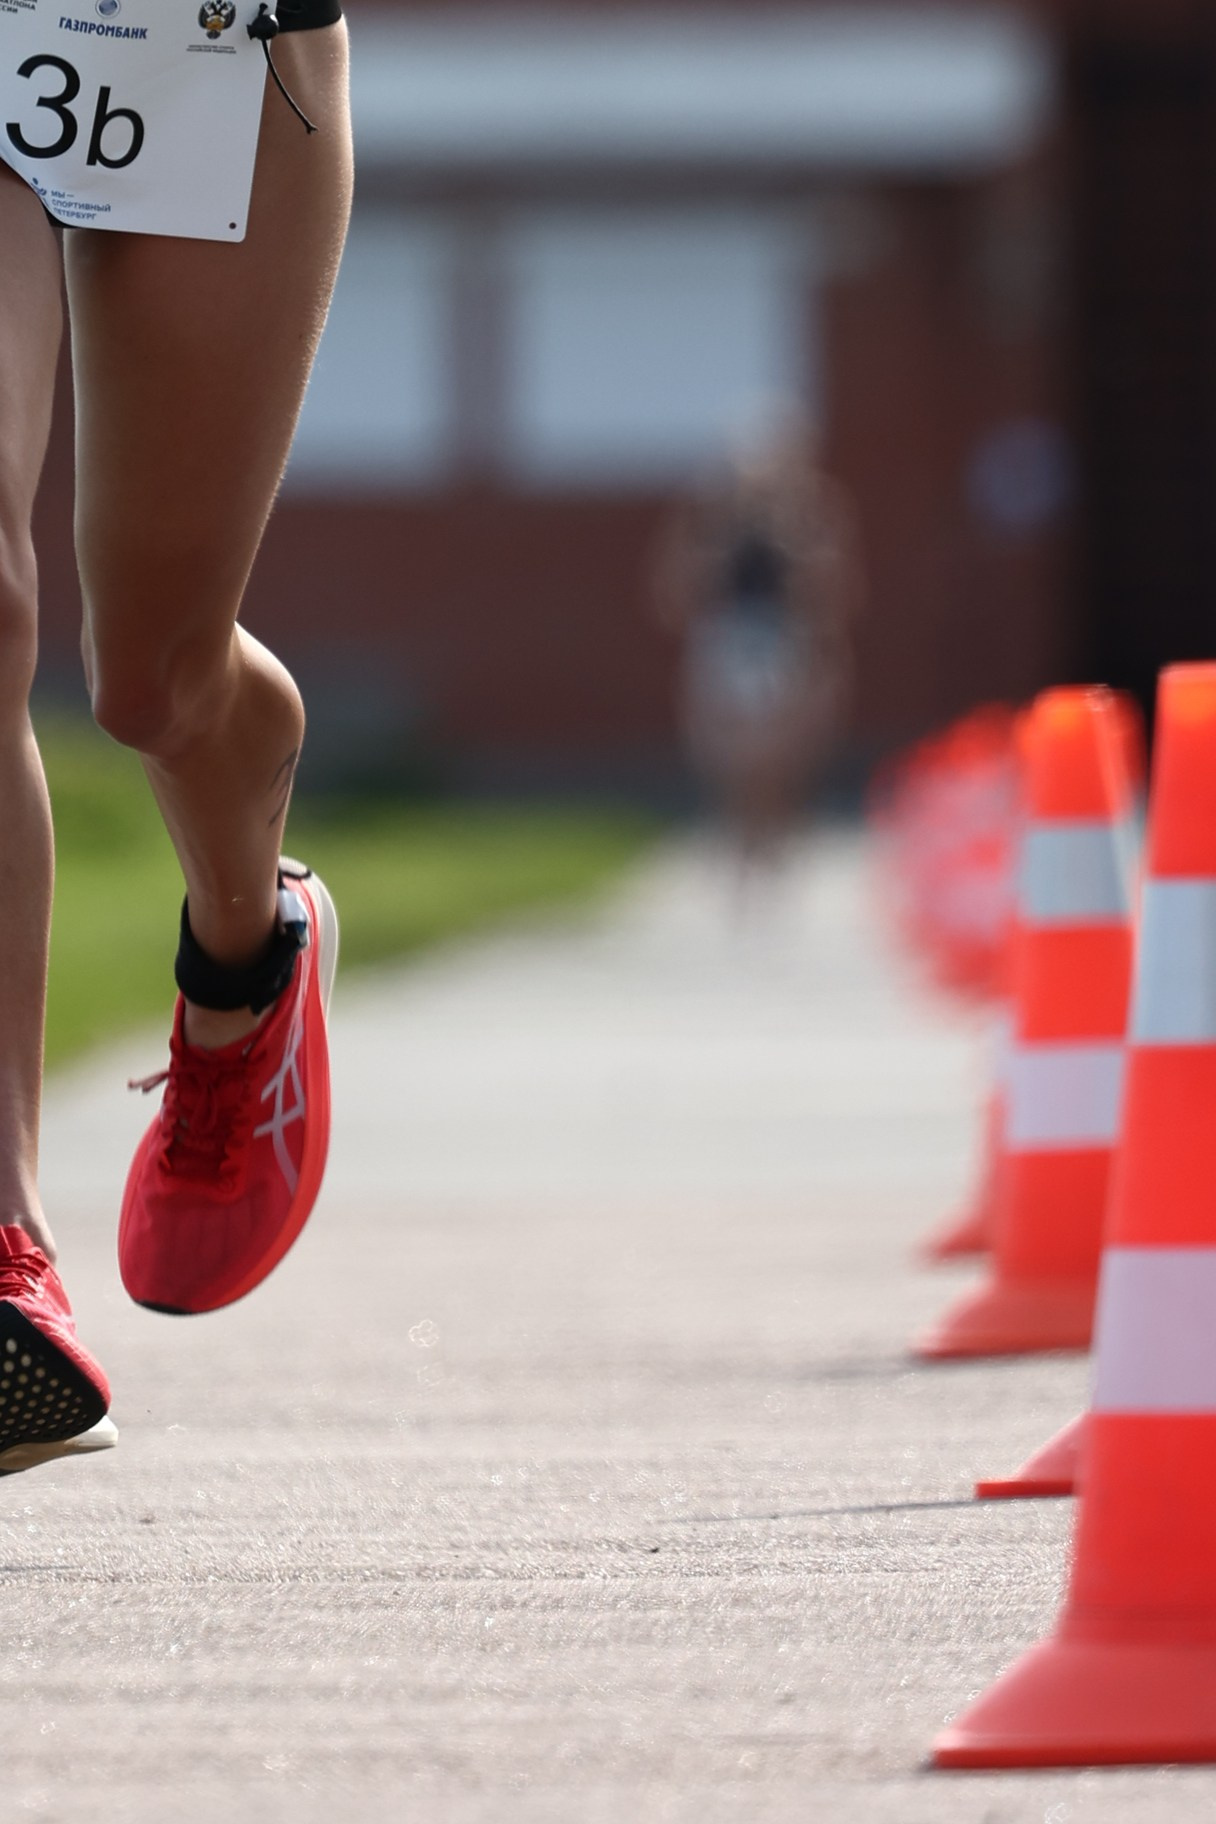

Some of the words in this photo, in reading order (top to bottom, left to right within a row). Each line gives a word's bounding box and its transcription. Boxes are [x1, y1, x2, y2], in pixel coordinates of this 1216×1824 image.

[59, 17, 148, 39] ГАЗПРОМБАНК
[52, 199, 111, 212] СПОРТИВНЫЙ
[53, 207, 97, 220] ПЕТЕРБУРГ
